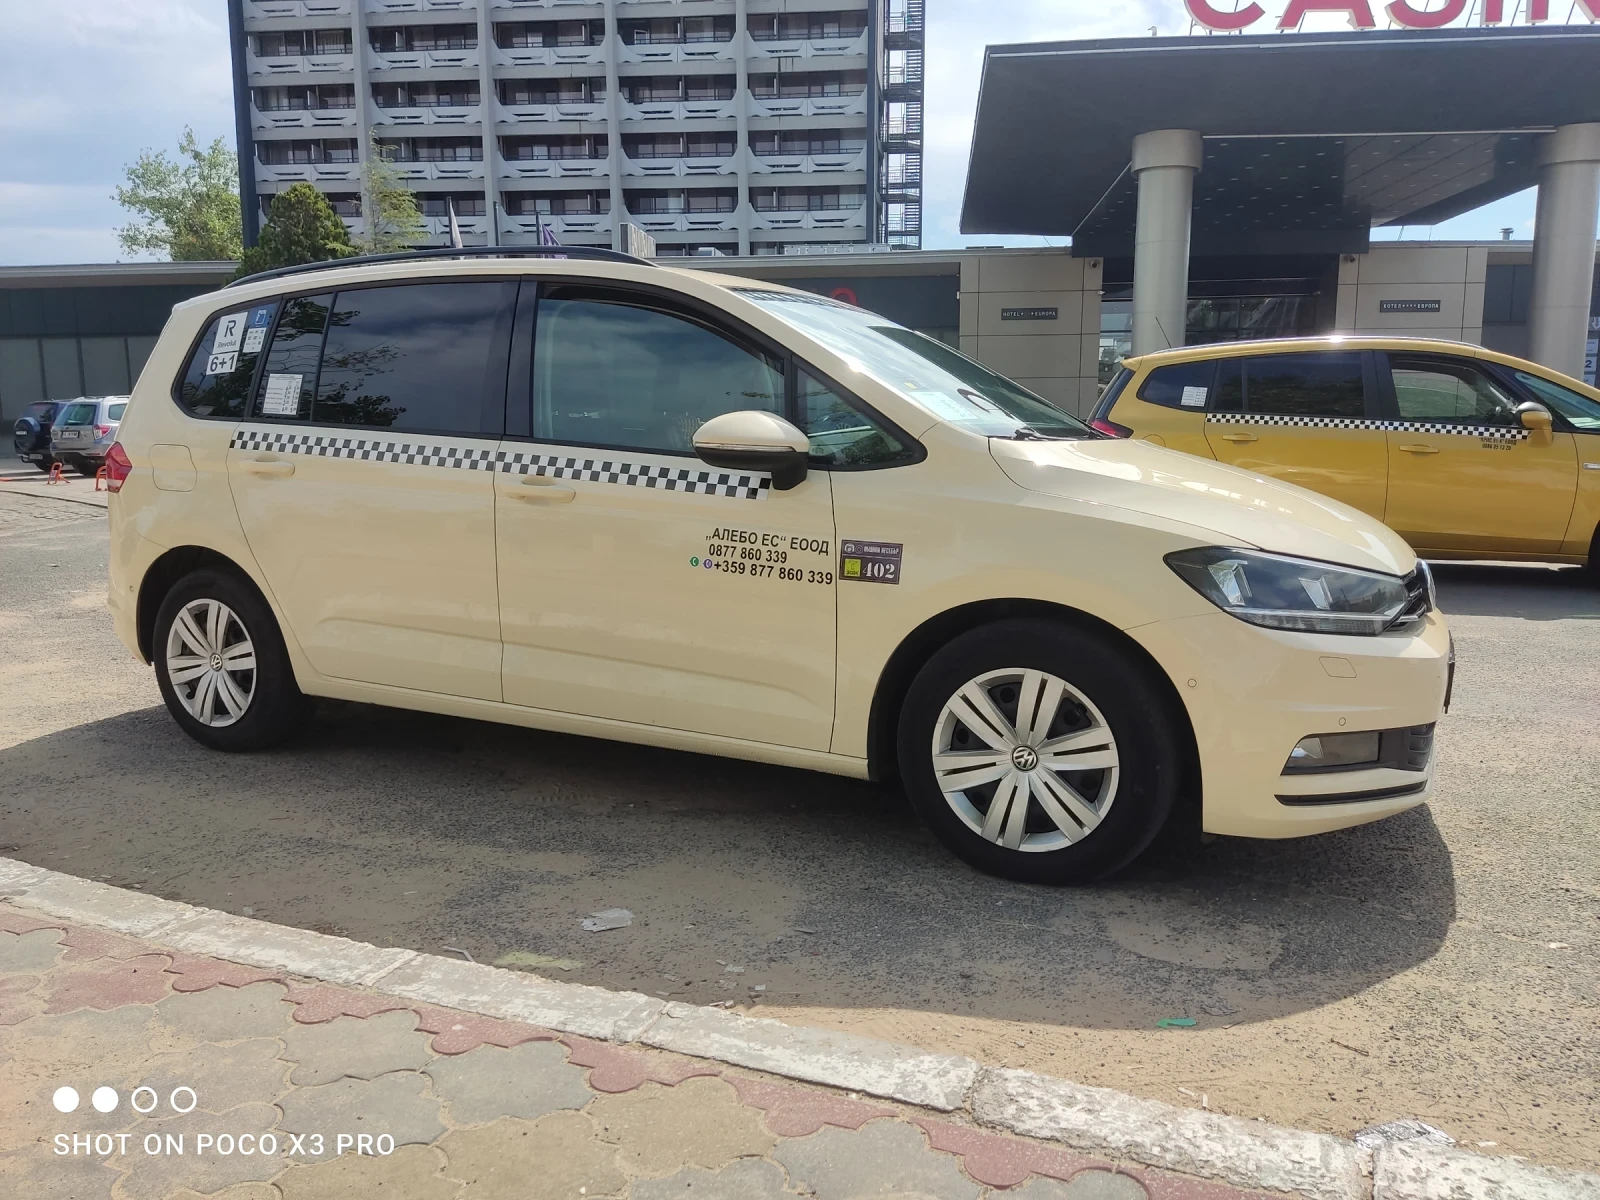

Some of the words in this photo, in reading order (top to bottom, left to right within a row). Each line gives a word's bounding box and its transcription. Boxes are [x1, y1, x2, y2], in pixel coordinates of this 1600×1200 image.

[224, 319, 237, 338] R
[217, 340, 237, 349] Revolut
[210, 354, 236, 373] 6+1
[709, 543, 737, 558] 0877
[740, 546, 762, 561] 860
[765, 549, 788, 564] 339
[790, 536, 829, 557] ЕООД
[713, 560, 746, 575] +359
[750, 563, 775, 578] 877
[778, 566, 803, 582] 860
[807, 570, 833, 585] 339
[862, 562, 895, 579] 402
